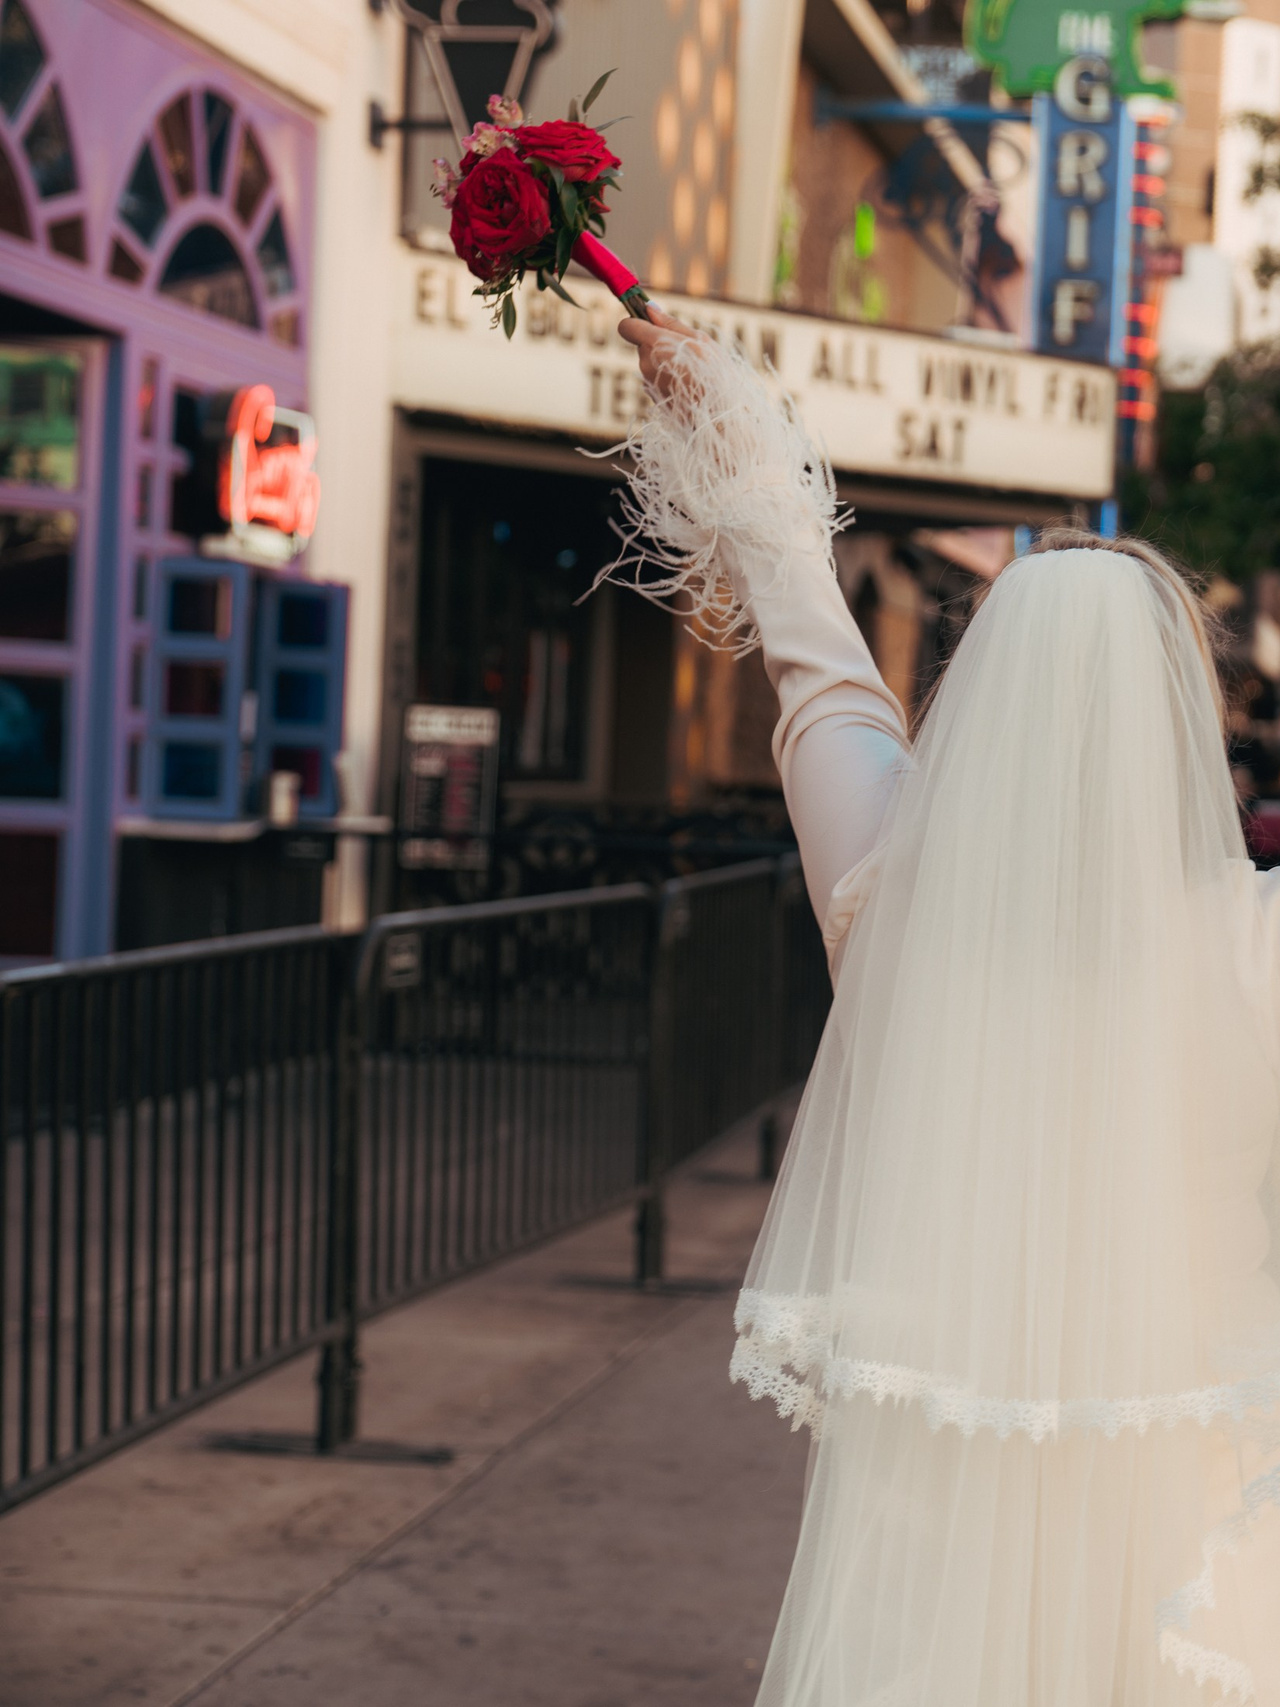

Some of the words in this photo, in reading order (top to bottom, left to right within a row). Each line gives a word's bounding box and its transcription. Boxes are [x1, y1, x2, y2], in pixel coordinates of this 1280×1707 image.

[811, 335, 885, 394] ALL
[919, 354, 1021, 417] VINYL
[896, 410, 968, 464] SAT
